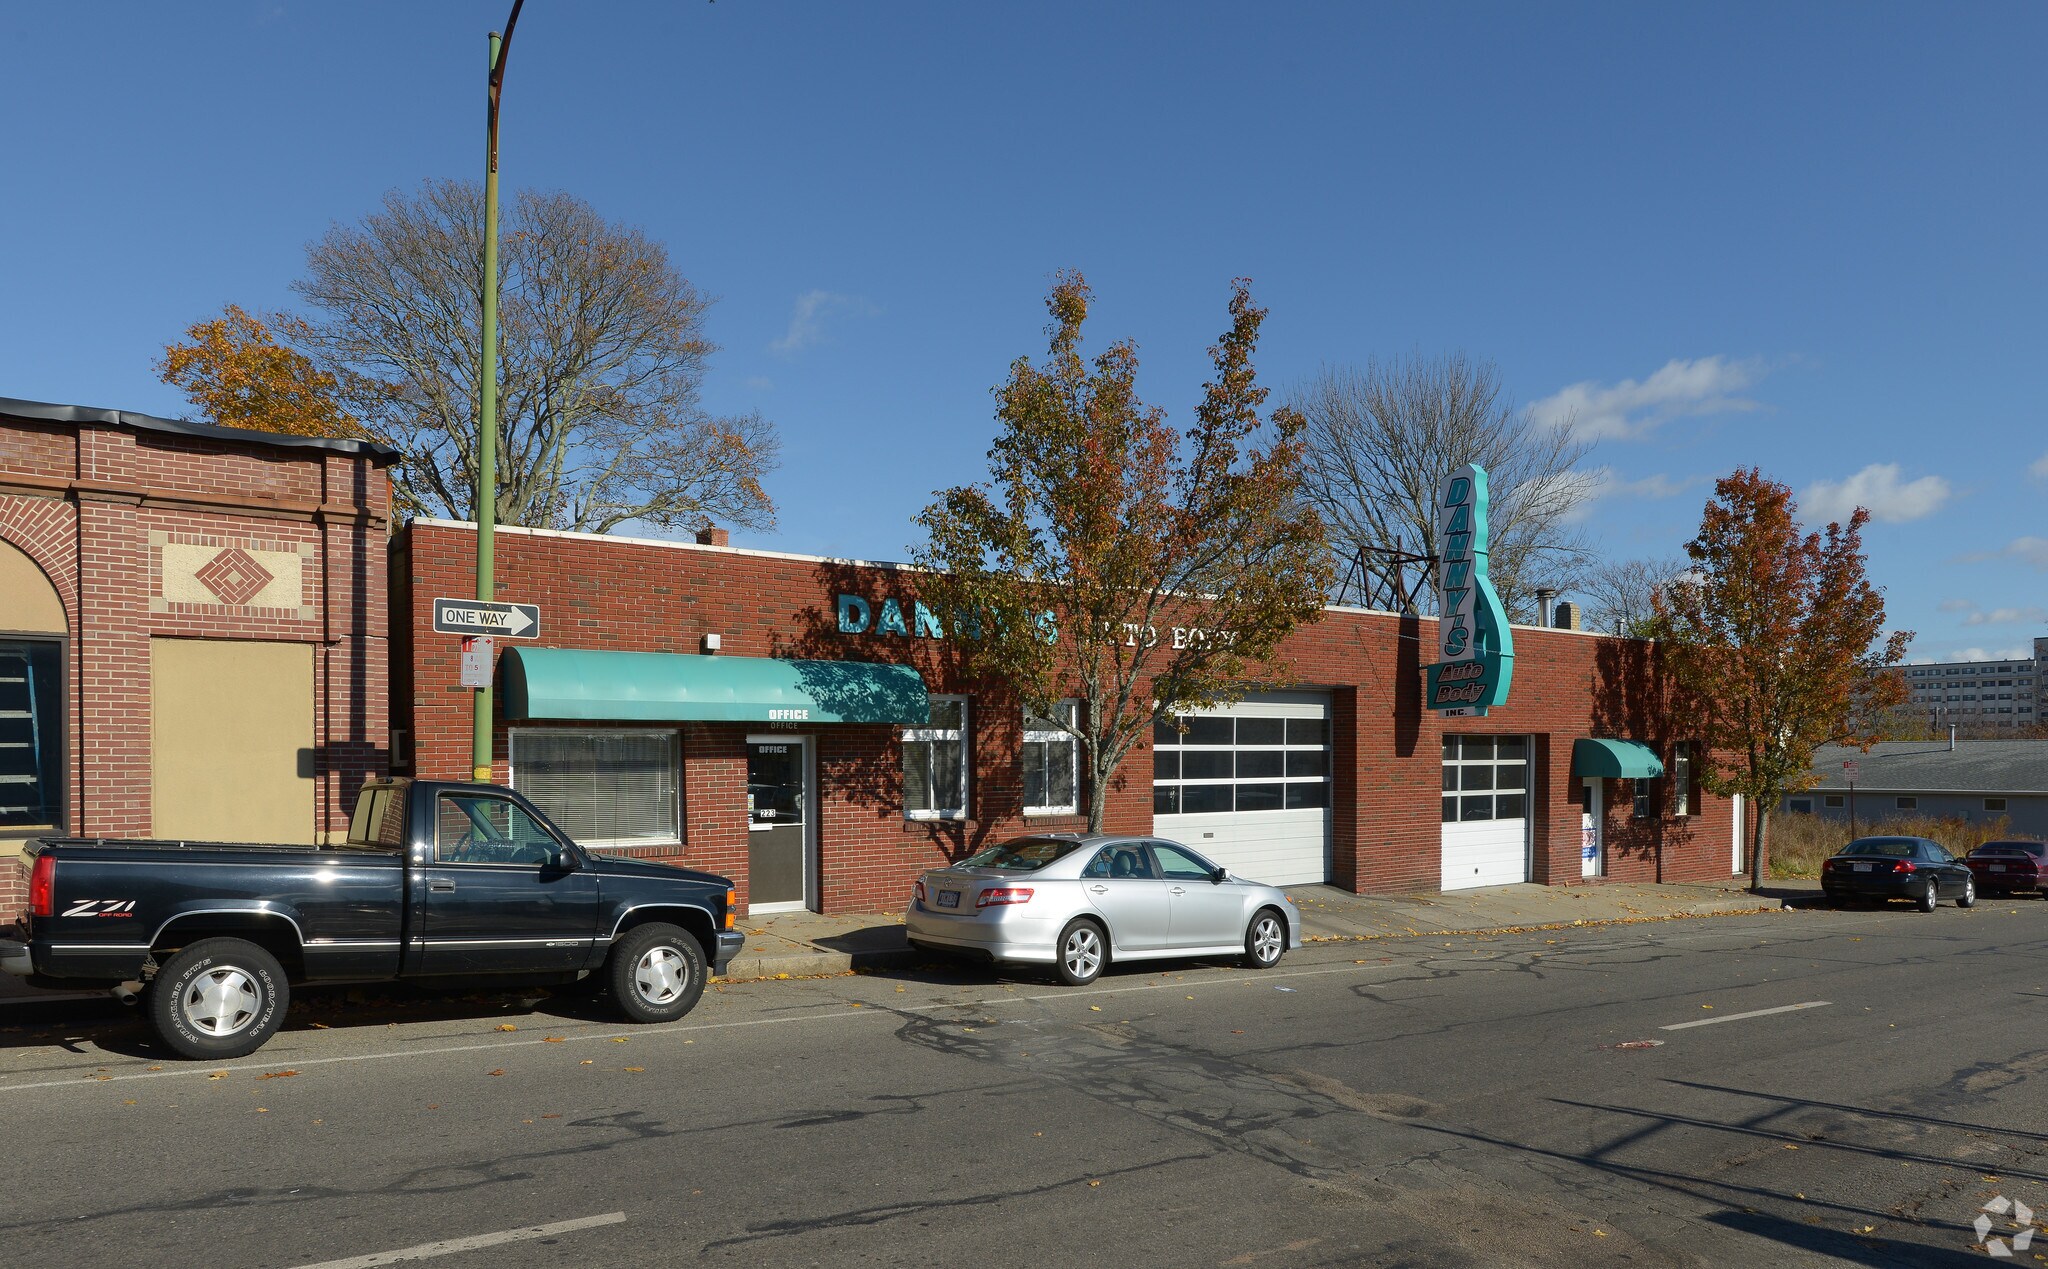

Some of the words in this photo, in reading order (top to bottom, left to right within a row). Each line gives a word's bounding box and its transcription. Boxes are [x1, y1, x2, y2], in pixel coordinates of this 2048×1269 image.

[1444, 477, 1470, 656] DANNY'S
[446, 609, 475, 624] ONE
[479, 612, 508, 626] WAY
[838, 593, 1059, 646] DANN'S
[1171, 626, 1239, 650] BOY
[1436, 661, 1485, 684] Auto
[1435, 682, 1486, 705] Body
[768, 709, 809, 720] OFFICE
[1446, 708, 1467, 717] INC.
[770, 721, 798, 730] OFFICE
[758, 745, 787, 754] OFFICE
[761, 809, 775, 818] 223
[61, 899, 136, 917] Z71
